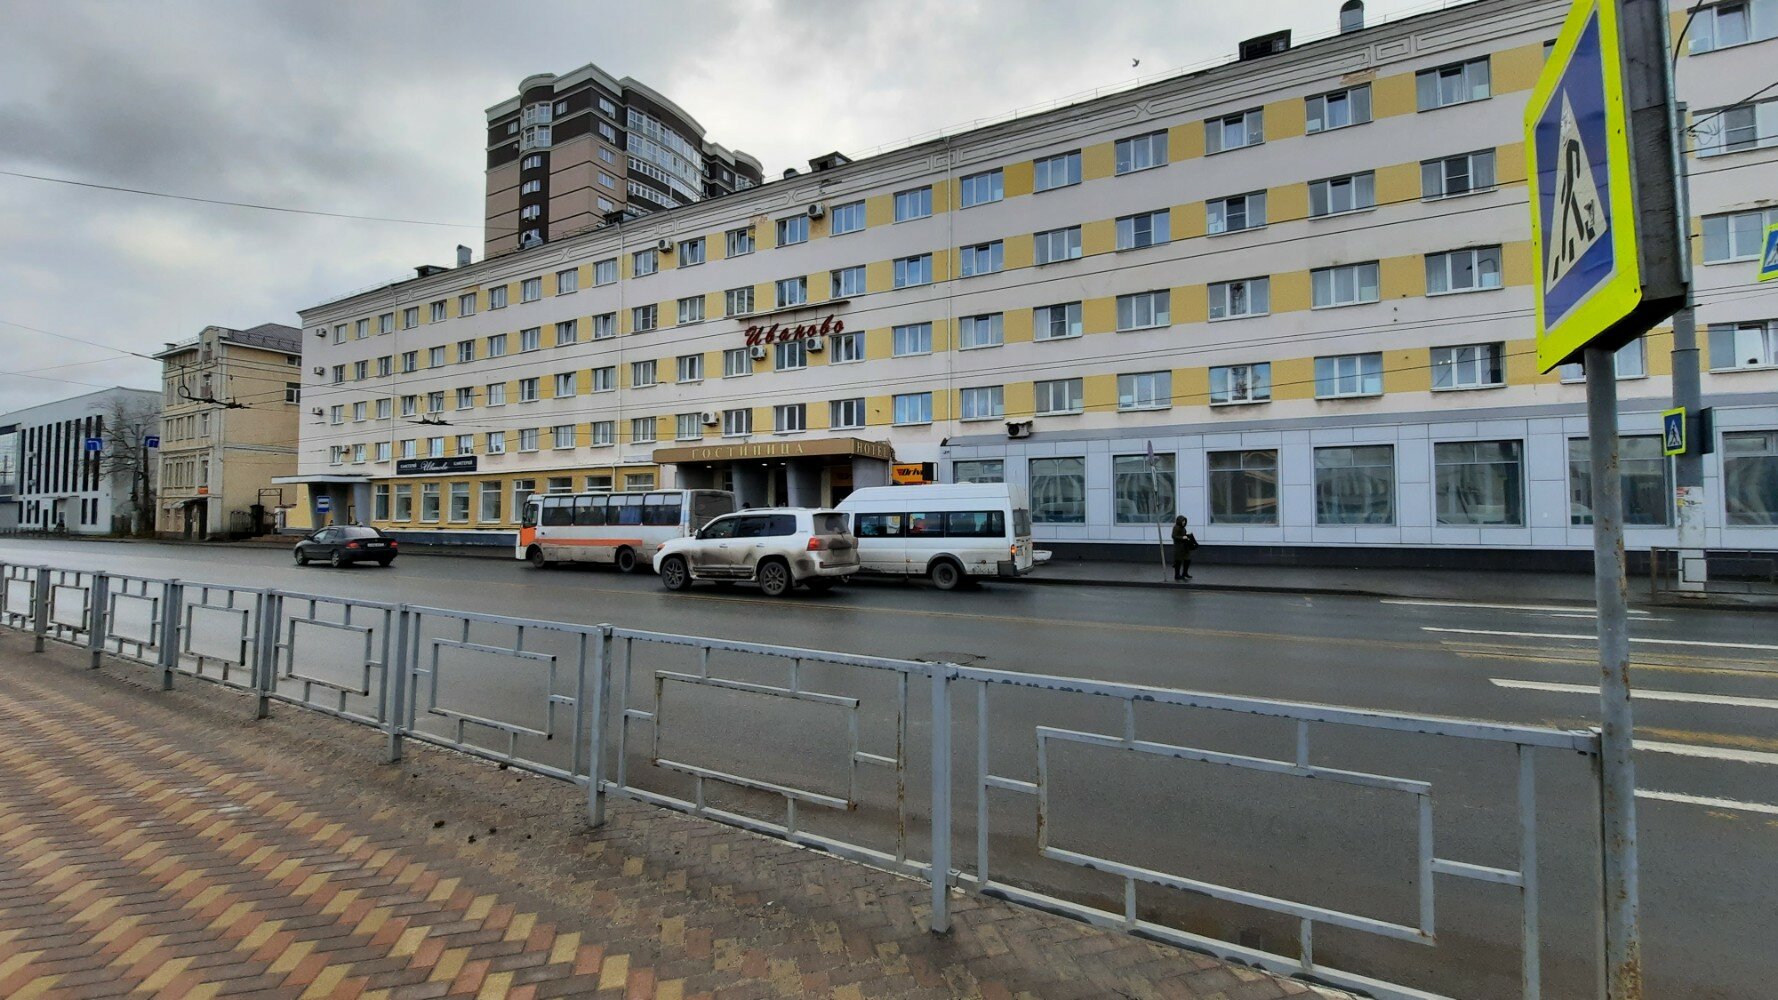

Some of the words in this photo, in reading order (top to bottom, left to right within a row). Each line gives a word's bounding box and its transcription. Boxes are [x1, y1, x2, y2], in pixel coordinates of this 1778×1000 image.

[745, 314, 844, 347] Иваново
[691, 443, 803, 459] ГОСТИНИЦА
[856, 441, 888, 458] HOTEL
